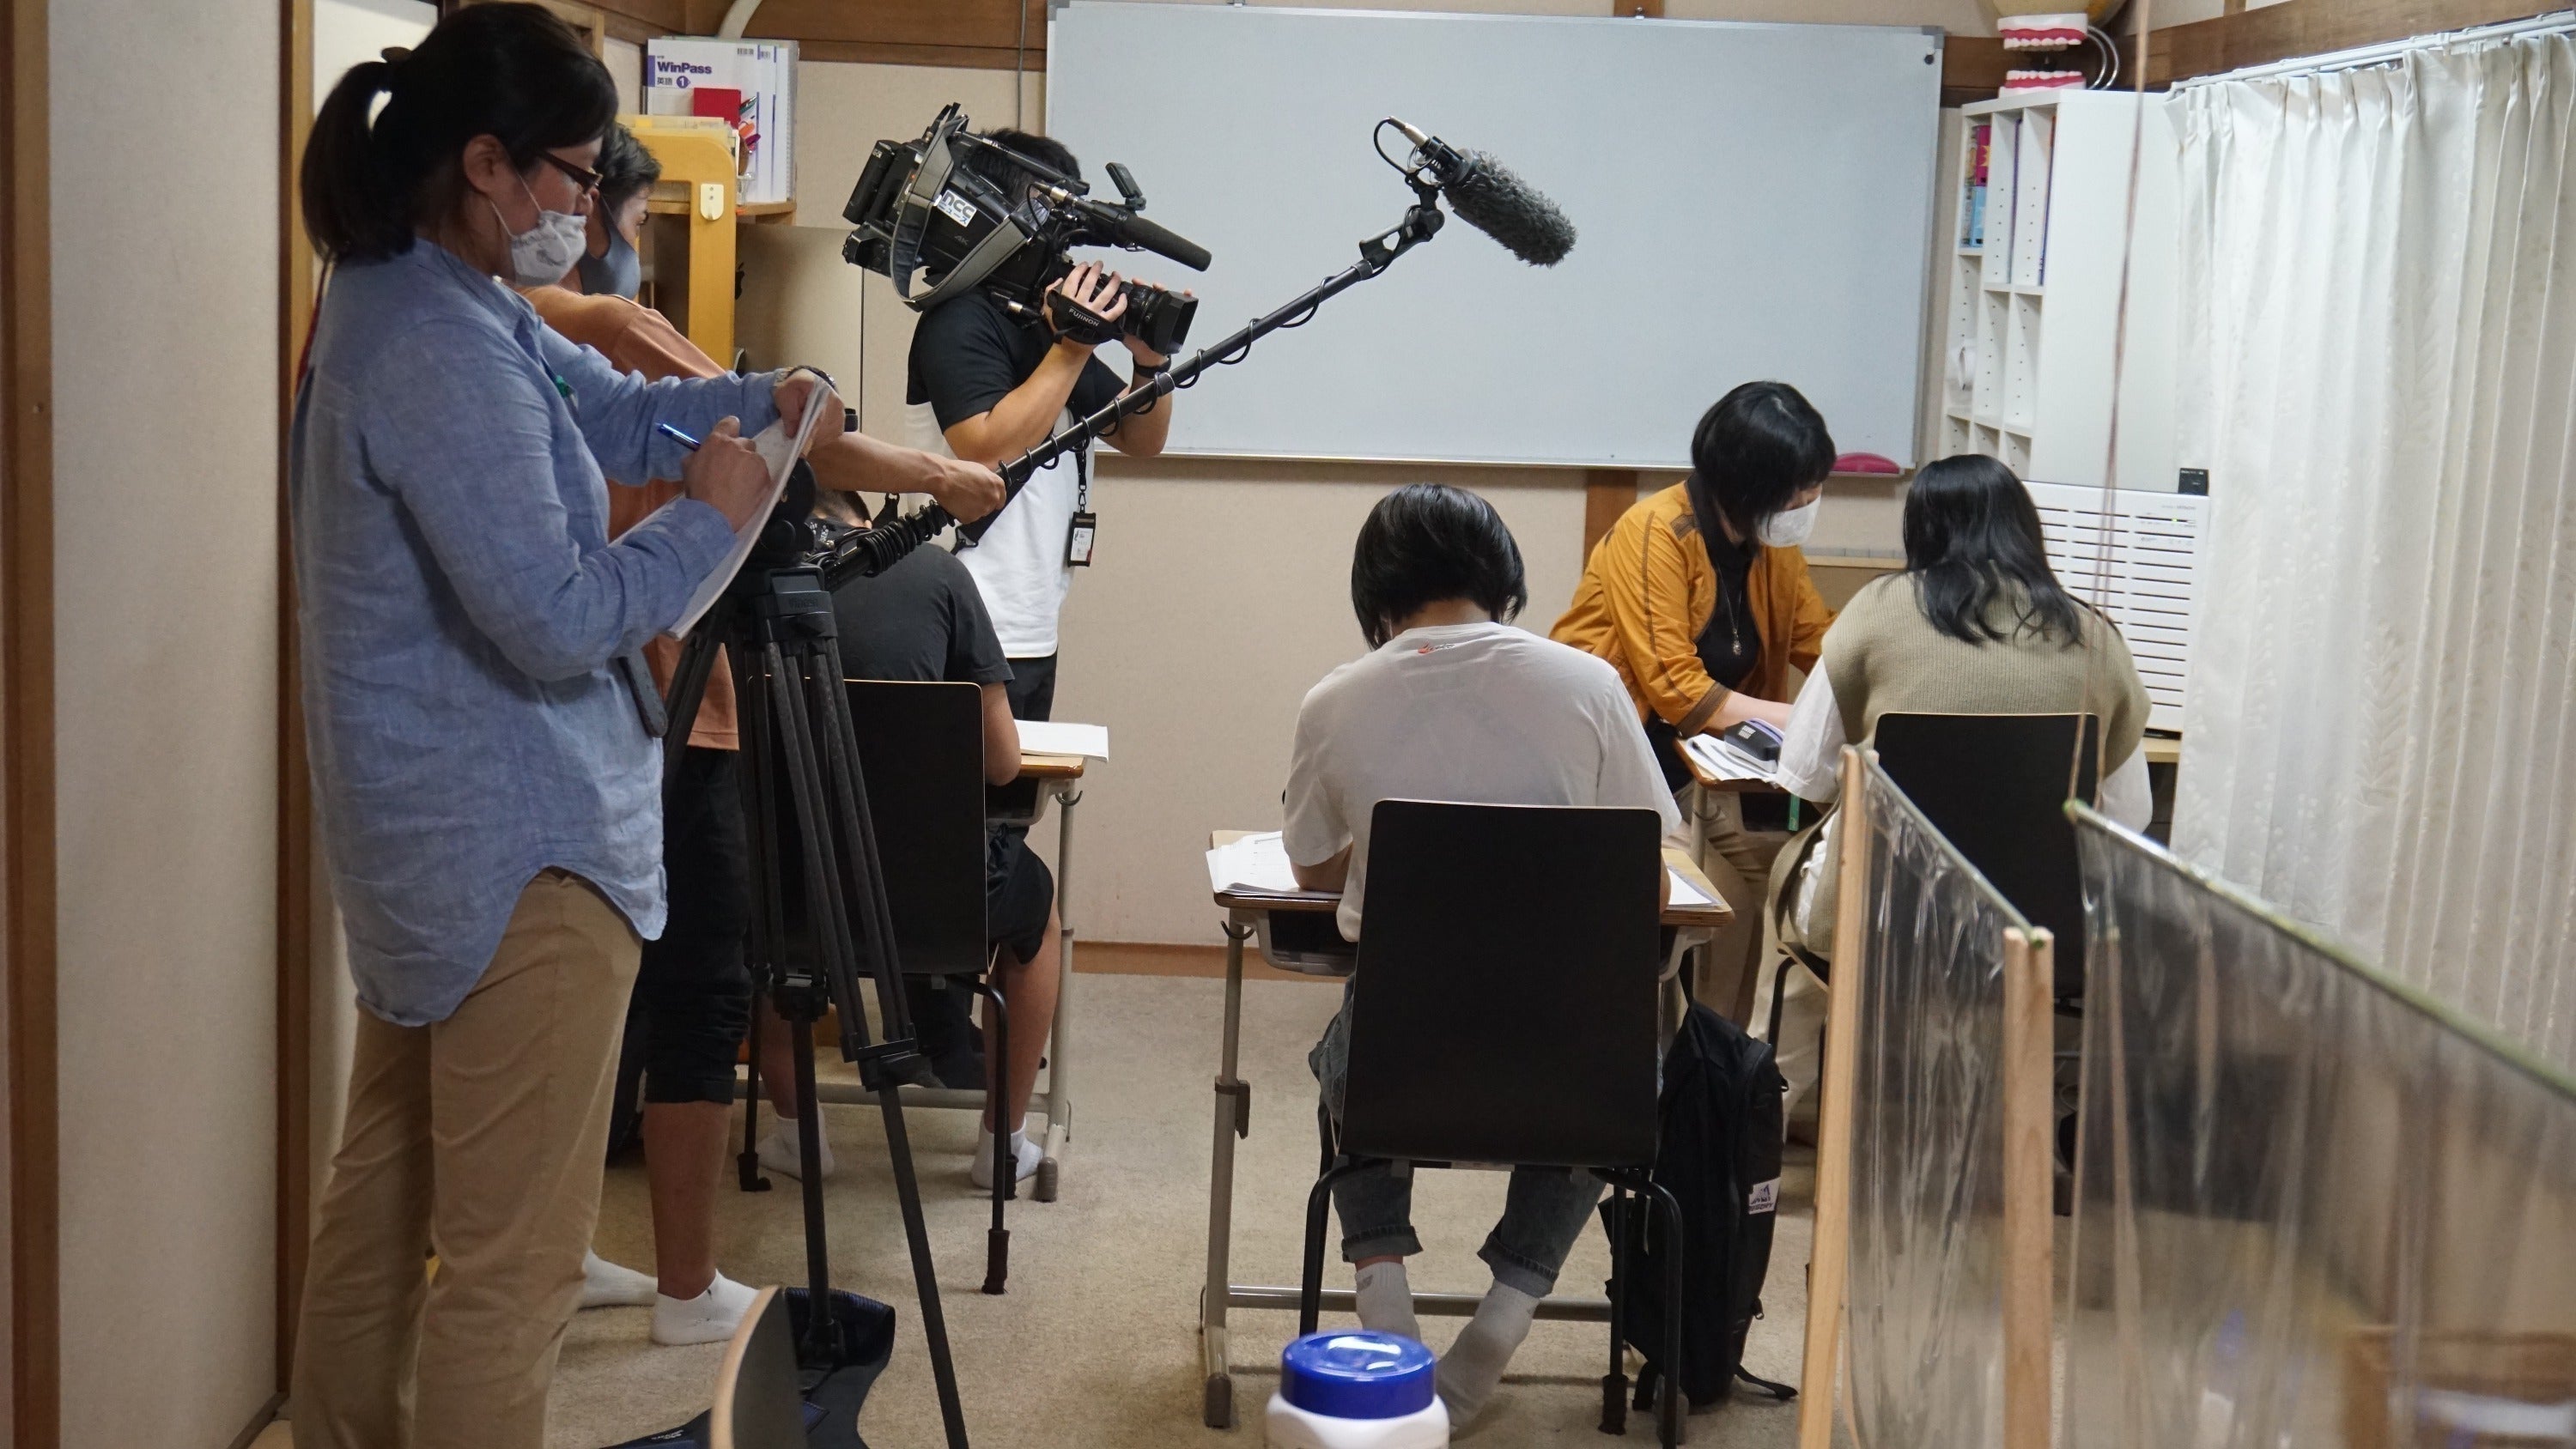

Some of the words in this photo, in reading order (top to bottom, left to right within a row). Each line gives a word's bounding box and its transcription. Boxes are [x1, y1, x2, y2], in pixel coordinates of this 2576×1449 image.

[657, 61, 713, 75] WinPass
[939, 202, 969, 225] ニュース
[942, 190, 975, 219] ncc
[1068, 307, 1100, 326] FUJINON
